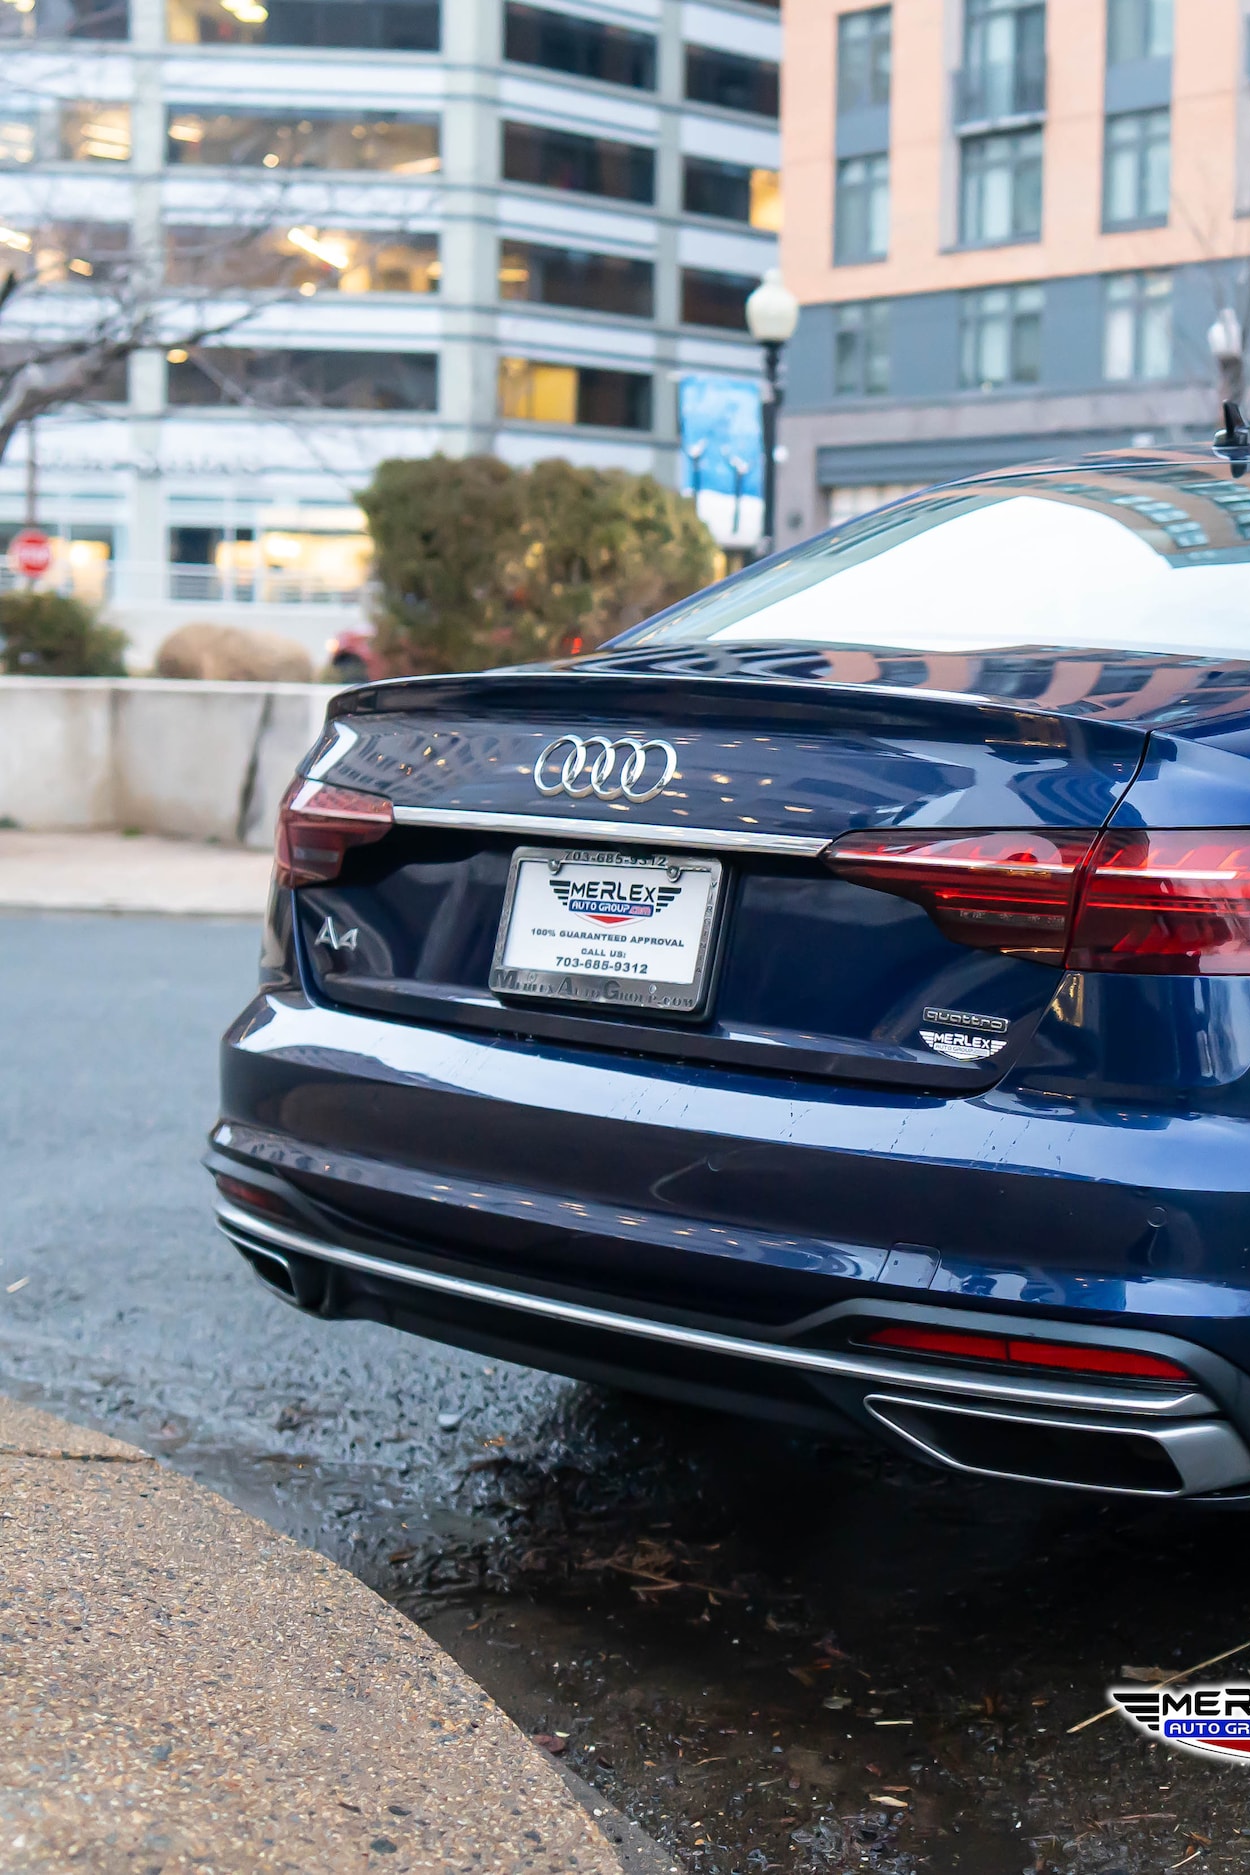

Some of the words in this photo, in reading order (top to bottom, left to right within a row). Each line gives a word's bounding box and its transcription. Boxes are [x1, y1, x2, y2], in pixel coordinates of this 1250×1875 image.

[570, 881, 656, 903] MERLEX
[571, 901, 597, 911] AUTO
[314, 915, 359, 951] A4
[531, 928, 556, 937] 100%
[559, 930, 627, 943] GUARANTEED
[629, 936, 684, 949] APPROVAL
[581, 947, 606, 958] CALL
[610, 949, 626, 959] US:
[555, 956, 648, 975] 703-685-9312
[926, 1010, 1003, 1029] quattro
[934, 1032, 991, 1049] MERLEX
